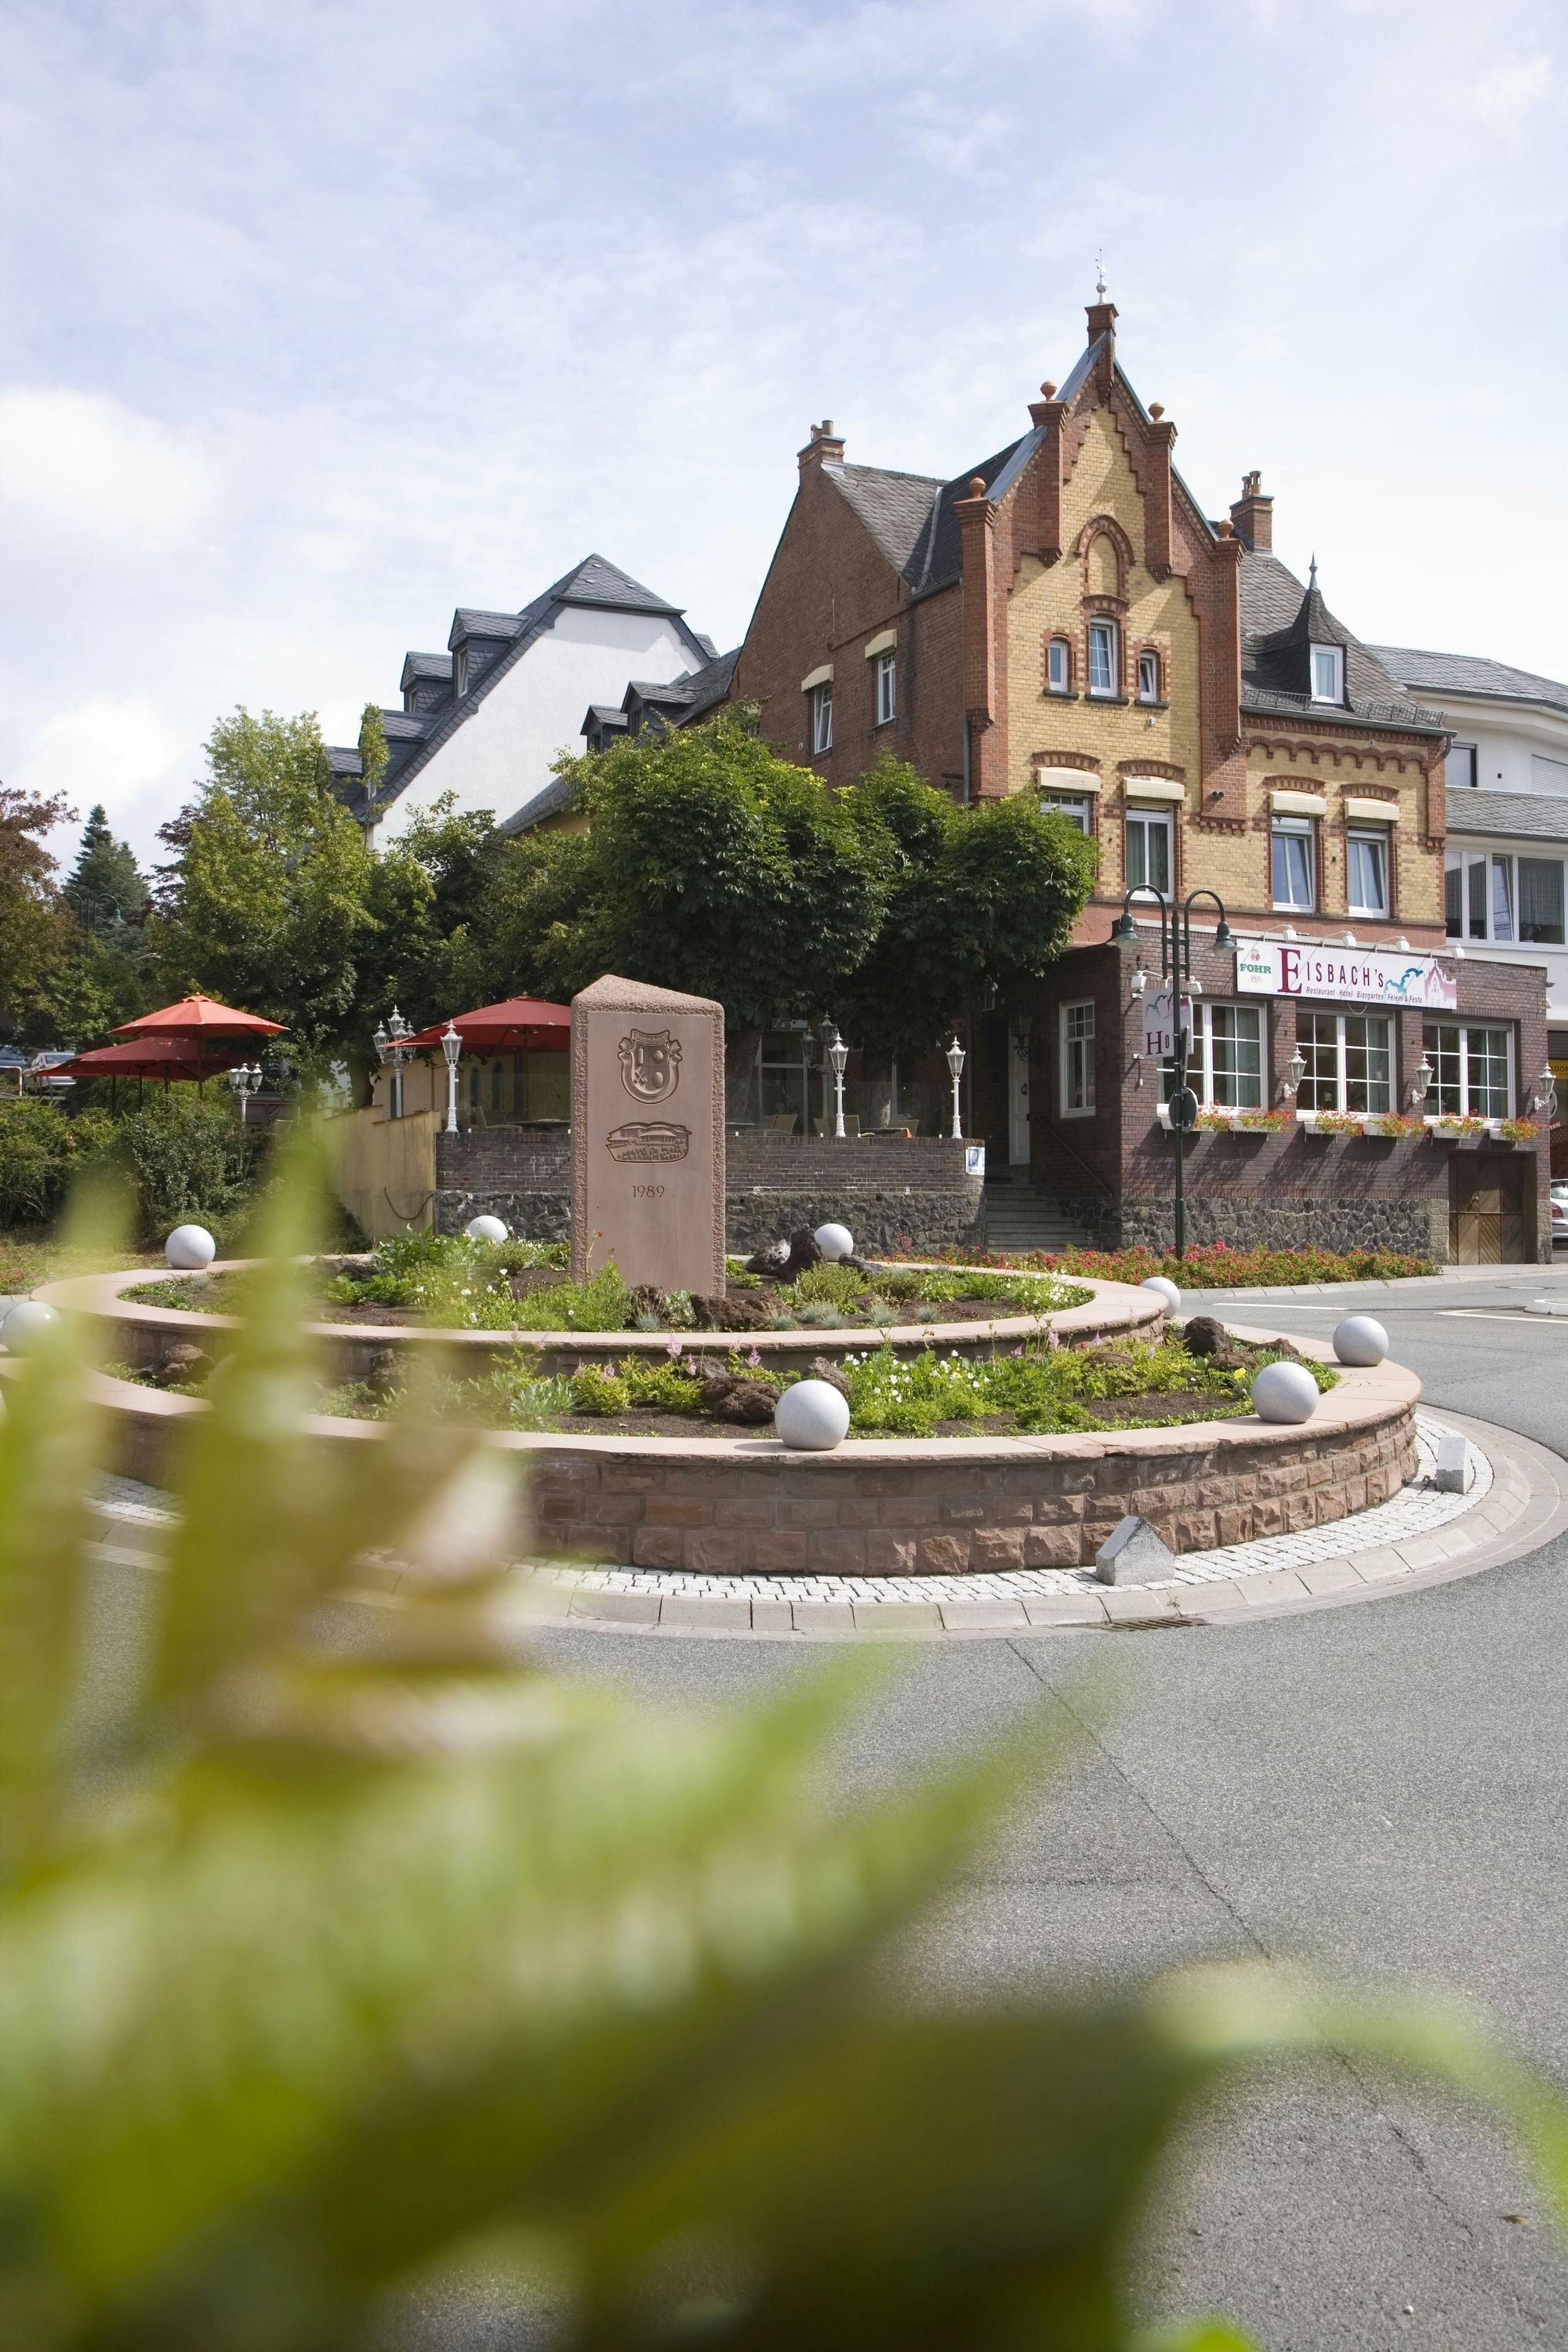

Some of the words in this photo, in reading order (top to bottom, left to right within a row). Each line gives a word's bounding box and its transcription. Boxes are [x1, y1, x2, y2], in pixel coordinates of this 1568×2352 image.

[1240, 964, 1271, 974] FOHR
[1306, 986, 1335, 996] Restaurant
[1356, 991, 1384, 1000] Biergarten
[631, 1185, 665, 1198] 1989
